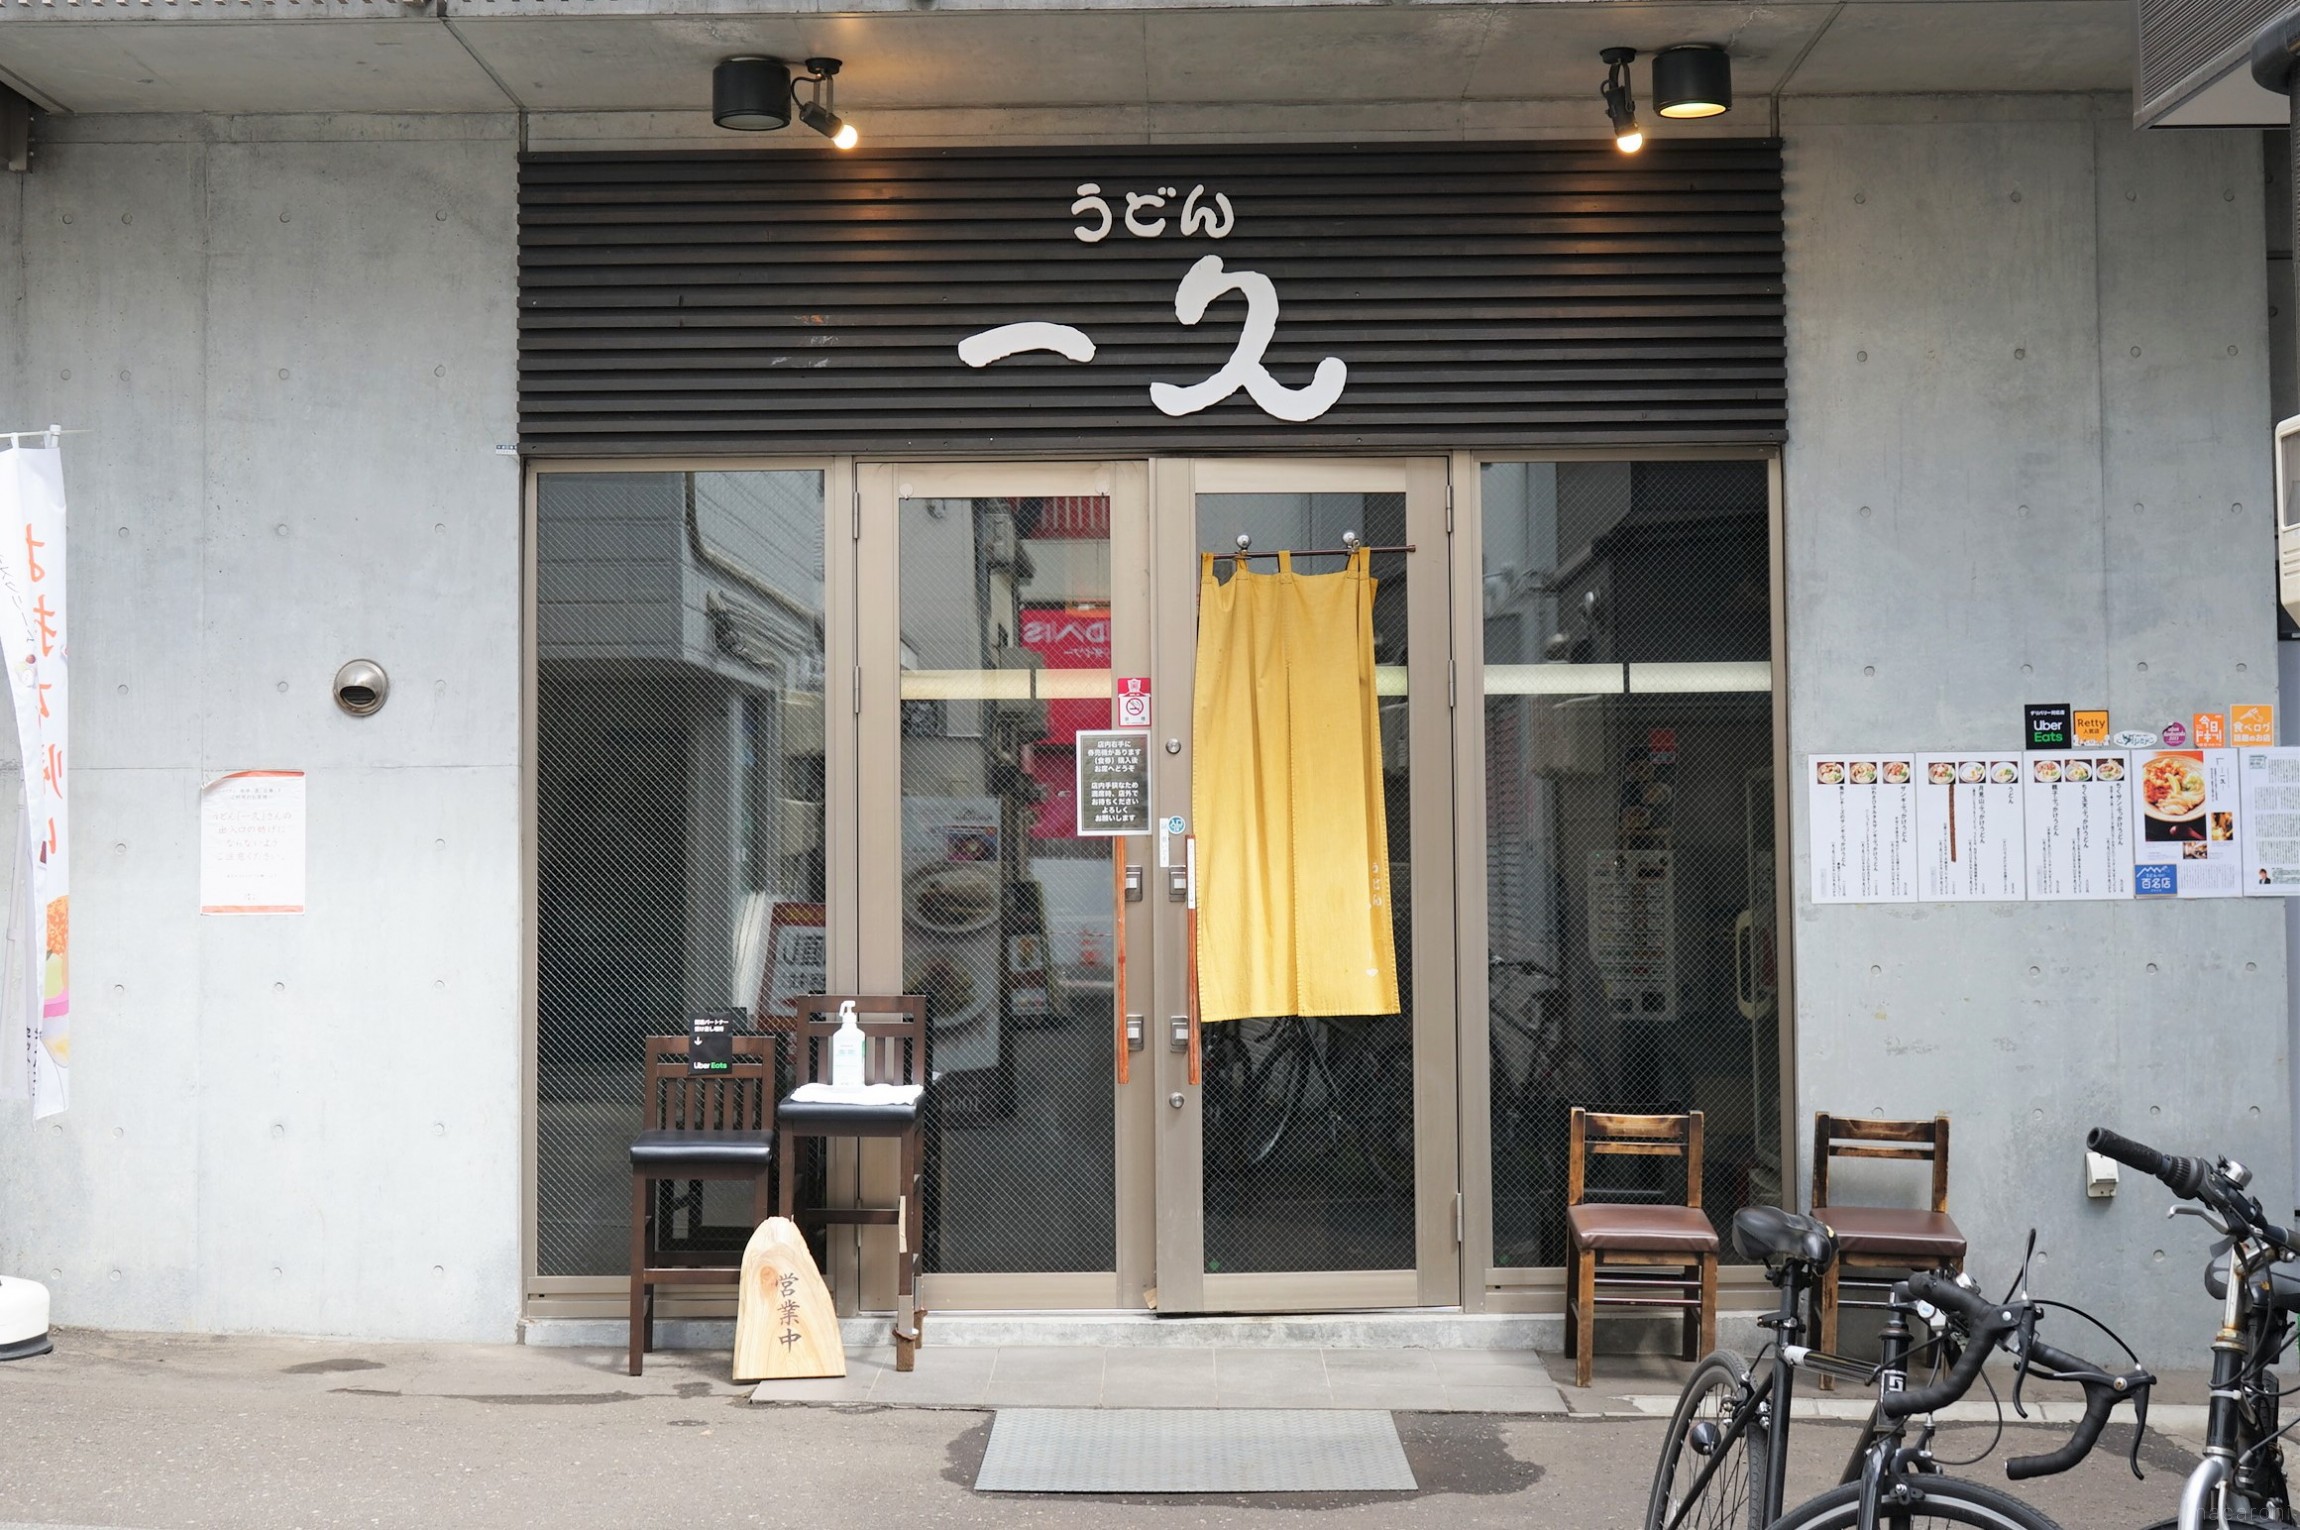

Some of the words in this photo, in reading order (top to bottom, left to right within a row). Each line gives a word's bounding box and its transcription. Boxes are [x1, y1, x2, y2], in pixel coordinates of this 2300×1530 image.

[1071, 182, 1235, 243] うどん
[957, 254, 1348, 422] 一久
[2033, 719, 2063, 731] Uber
[2077, 718, 2106, 728] Retty
[2233, 721, 2271, 733] 食べログ
[2034, 731, 2063, 743] Eats
[1097, 740, 1132, 748] 店内右手に
[1091, 798, 1139, 806] お待ちください
[1101, 806, 1128, 814] よろしく
[1095, 814, 1136, 823] お願いします
[2140, 877, 2171, 890] 百名店
[693, 1061, 710, 1070] Uber
[710, 1061, 728, 1069] Eats
[777, 1272, 802, 1354] 営業中
